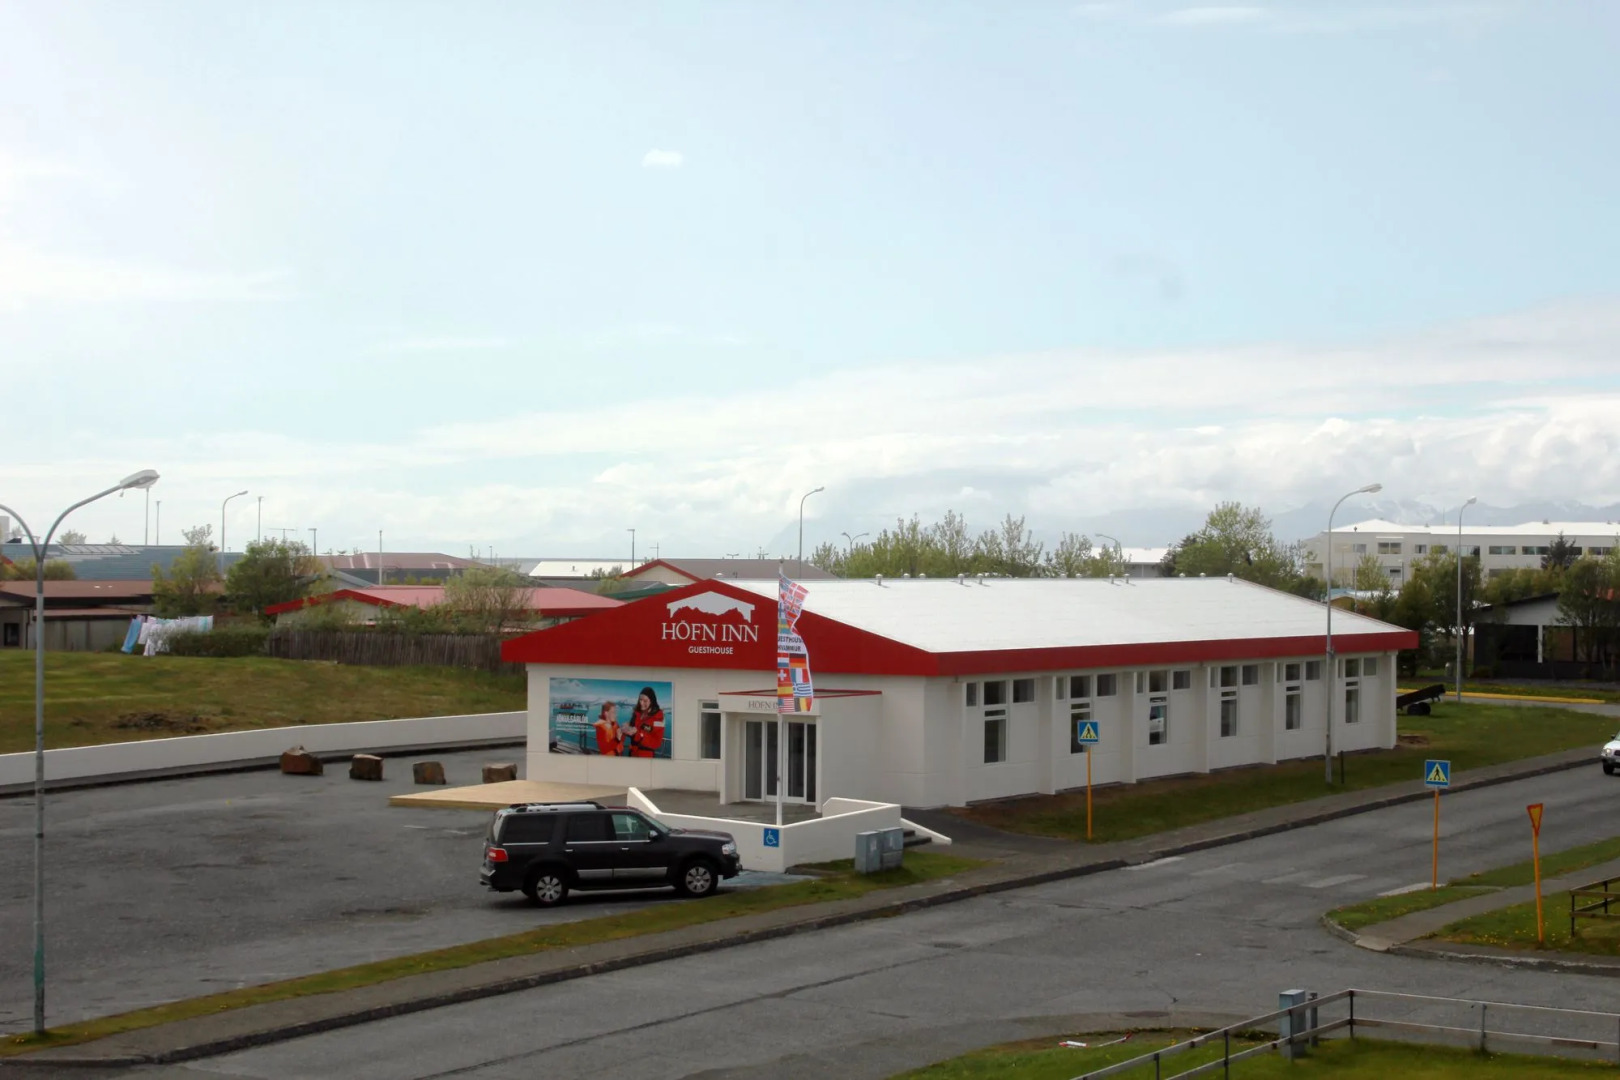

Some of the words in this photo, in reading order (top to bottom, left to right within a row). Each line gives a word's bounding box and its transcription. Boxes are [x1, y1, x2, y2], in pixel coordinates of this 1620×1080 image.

[661, 620, 717, 641] HÖFN
[721, 624, 759, 642] INN
[688, 646, 734, 655] GUESTHOUSE
